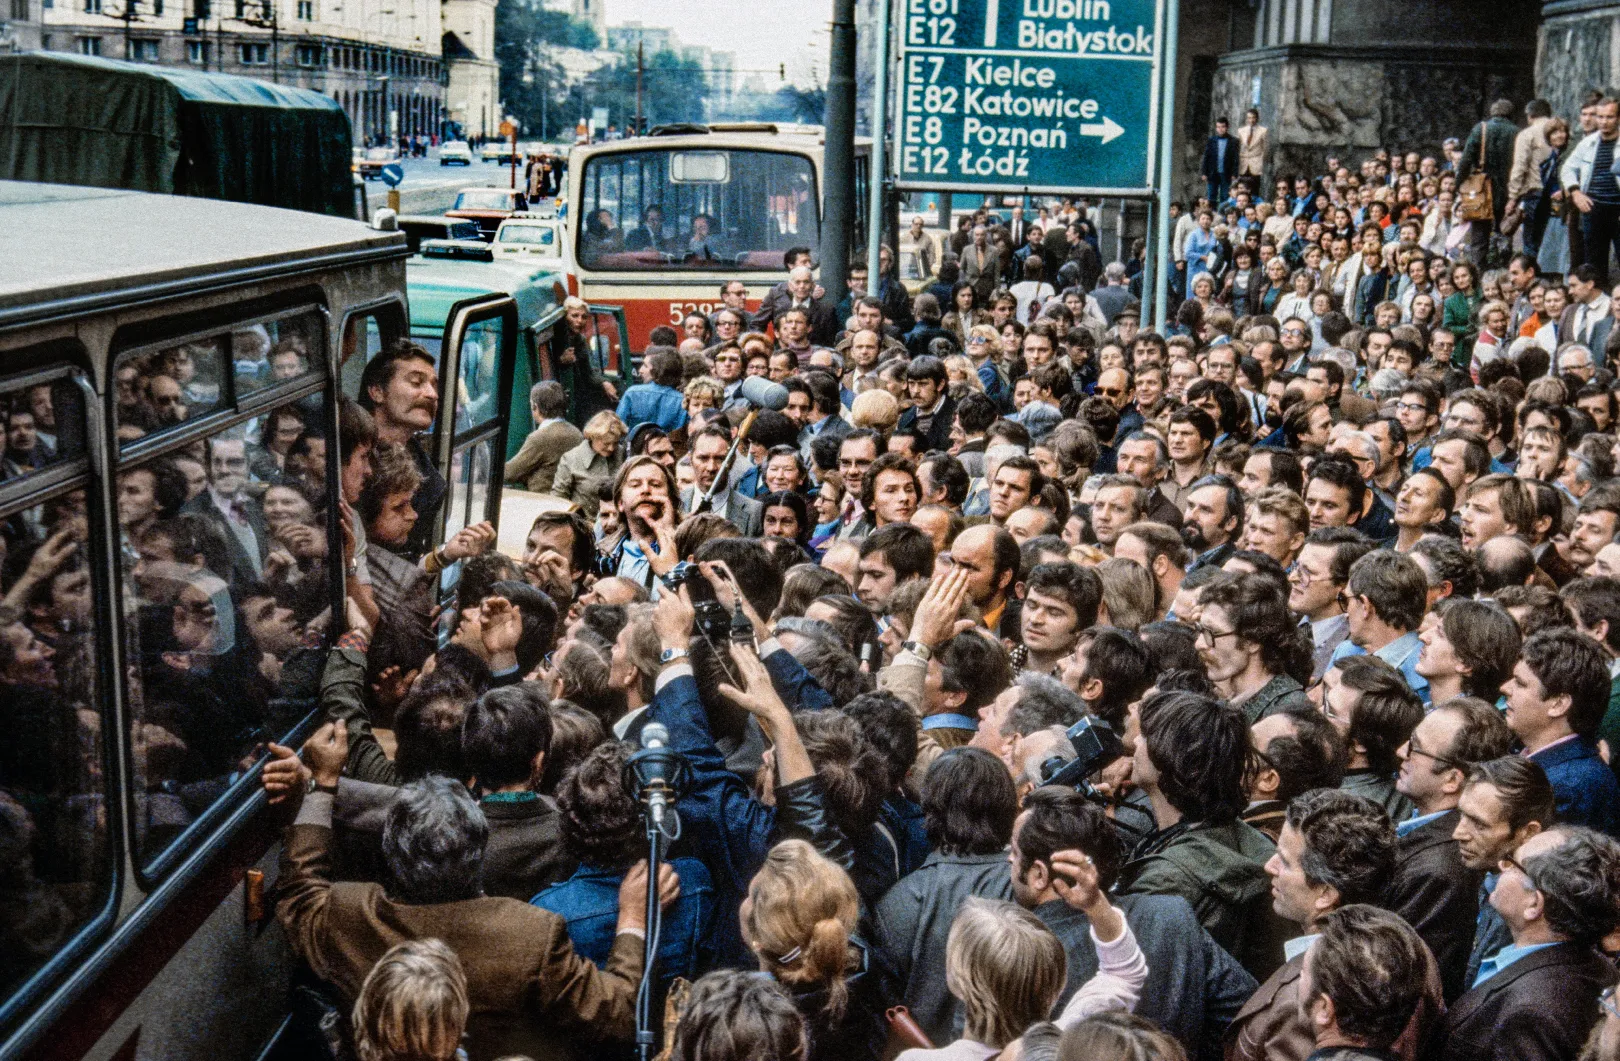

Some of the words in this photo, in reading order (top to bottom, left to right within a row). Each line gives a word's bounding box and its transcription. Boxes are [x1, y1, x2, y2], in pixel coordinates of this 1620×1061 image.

[1023, 0, 1111, 20] Lublin
[908, 16, 956, 46] E12
[1017, 19, 1153, 54] Białystok
[964, 56, 1056, 88] Kielce
[906, 85, 959, 114] E82
[963, 86, 1099, 119] Katowice
[962, 116, 1067, 149] Poznań
[903, 146, 950, 174] E12
[957, 147, 1029, 176] Łódź
